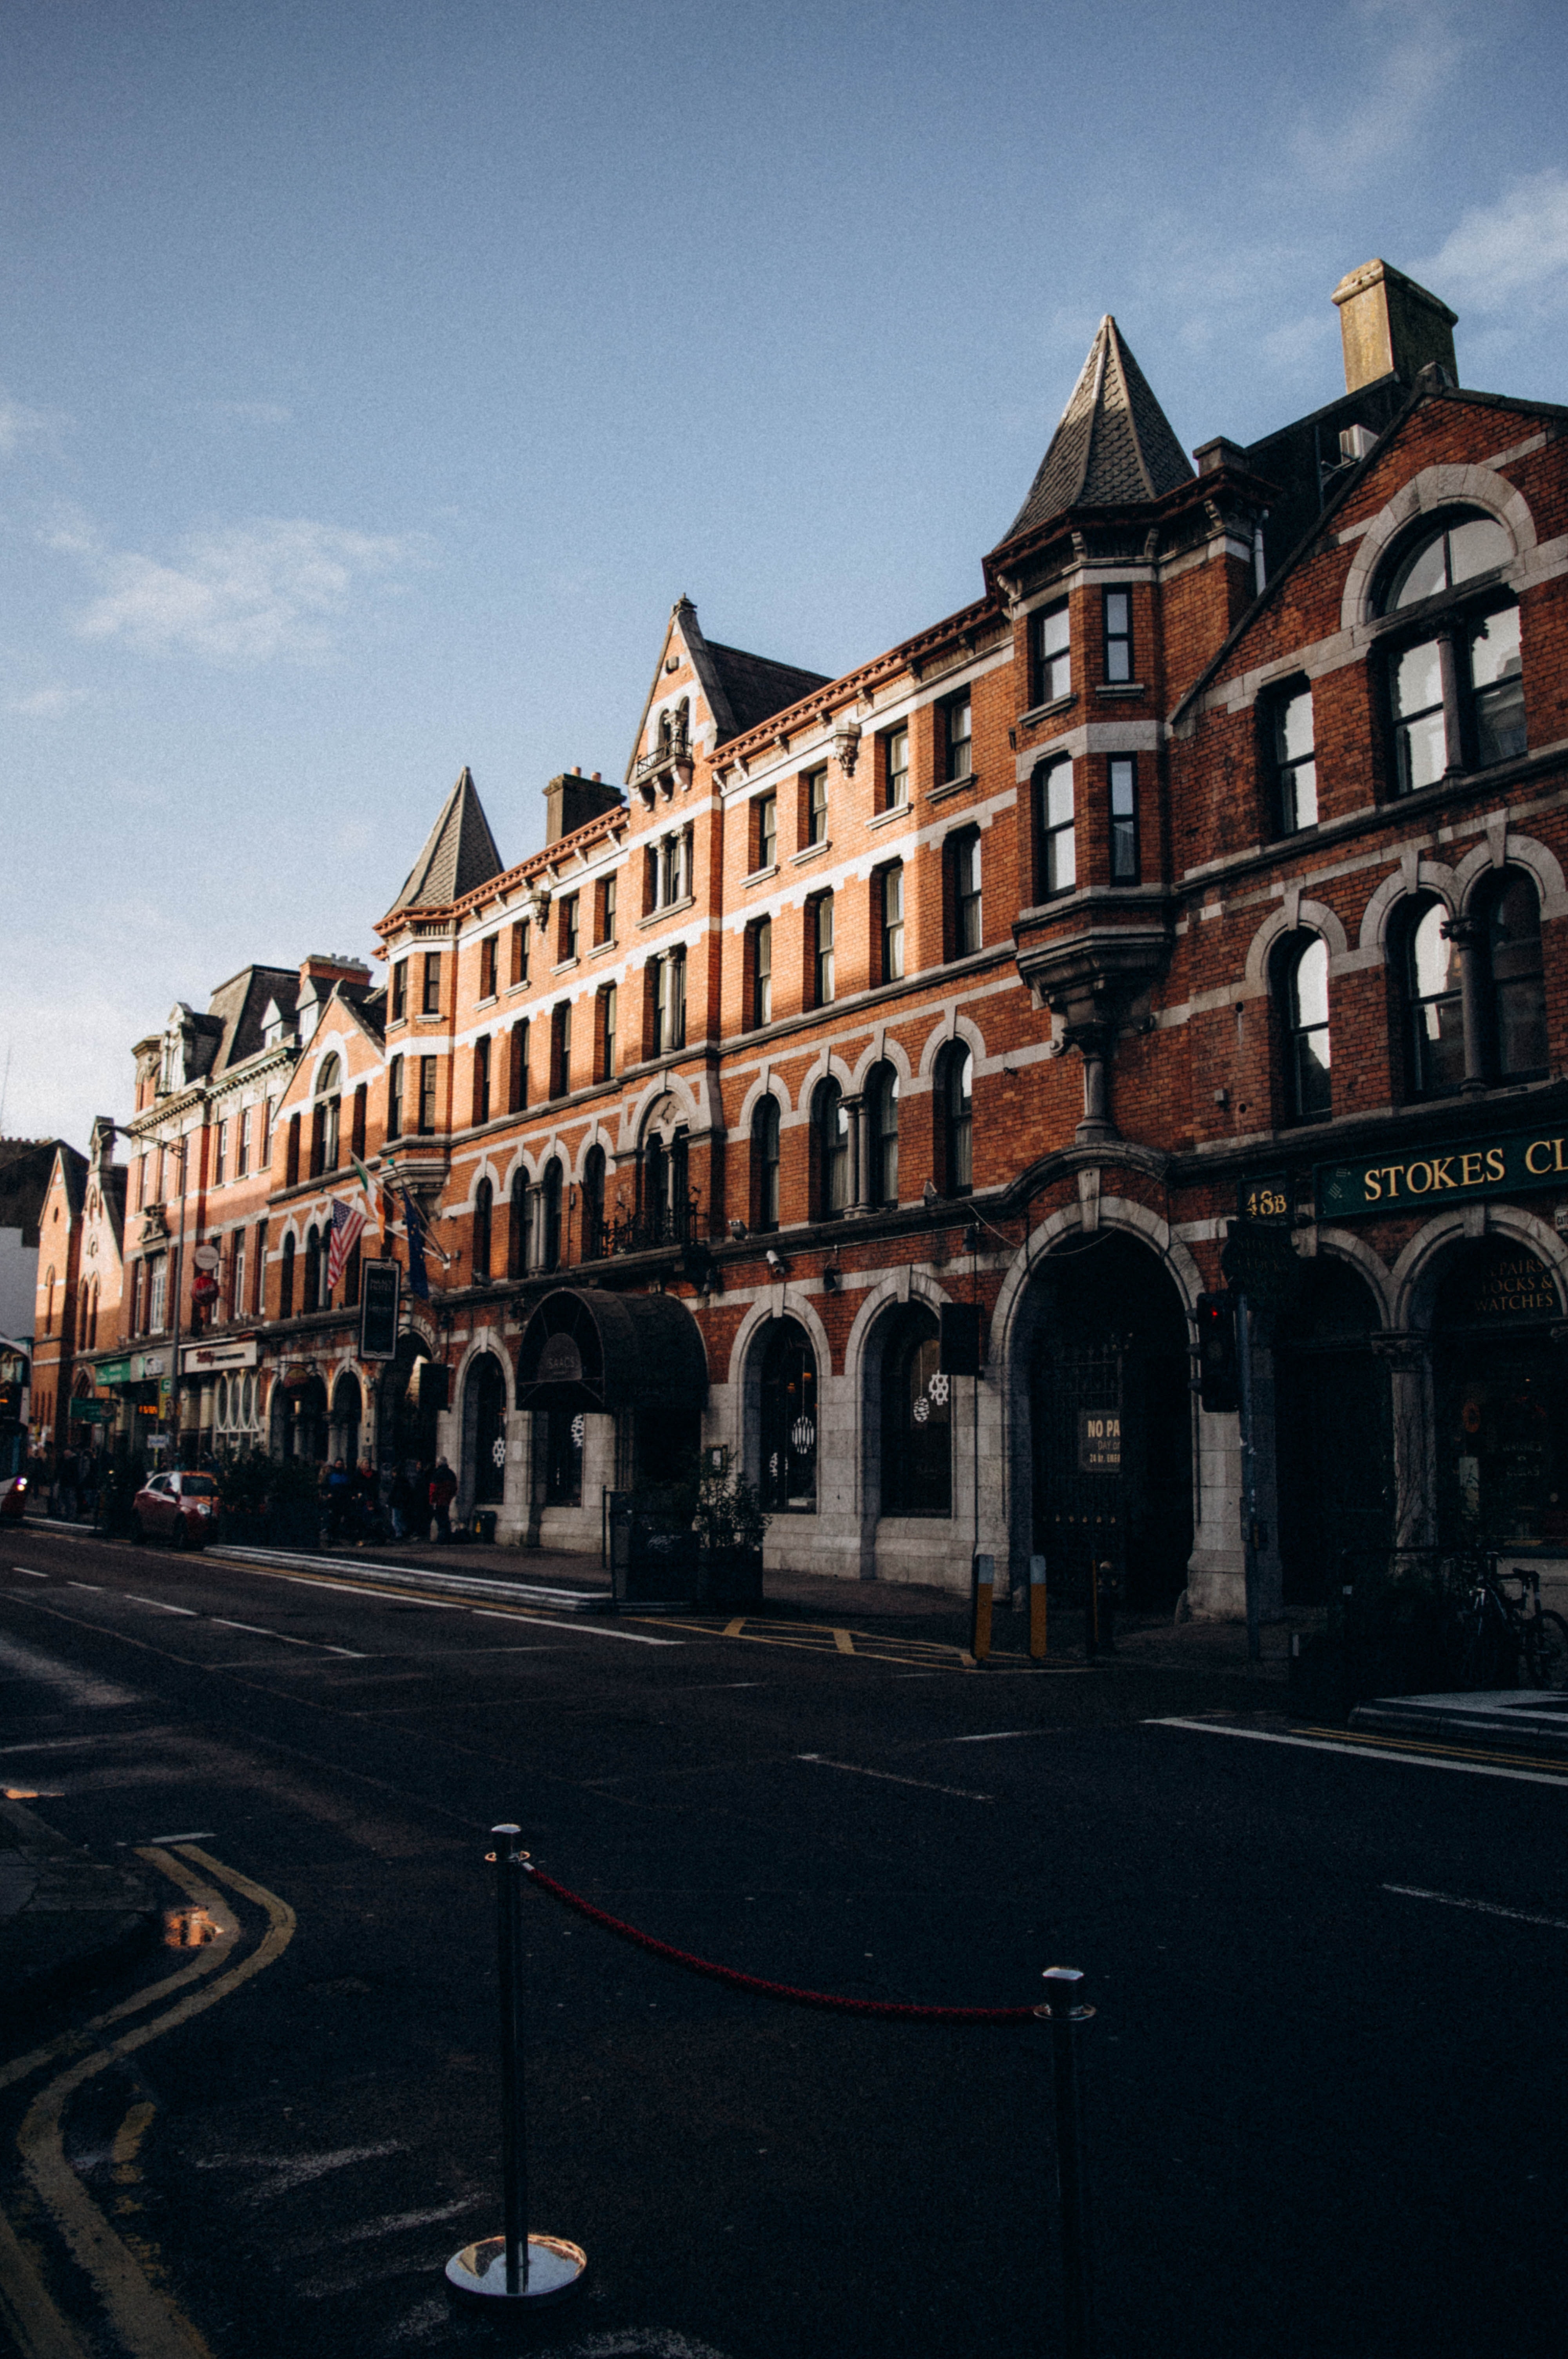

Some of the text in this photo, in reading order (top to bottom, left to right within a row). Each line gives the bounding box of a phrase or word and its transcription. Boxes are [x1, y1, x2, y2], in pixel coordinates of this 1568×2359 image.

[1364, 1148, 1506, 1201] STOKES
[1245, 1190, 1287, 1218] 48B
[1541, 1274, 1553, 1289] &
[1474, 1292, 1553, 1311] WATCHES
[1088, 1419, 1121, 1438] NO PA
[1098, 1440, 1111, 1450] DAY
[1090, 1453, 1096, 1463] 24
